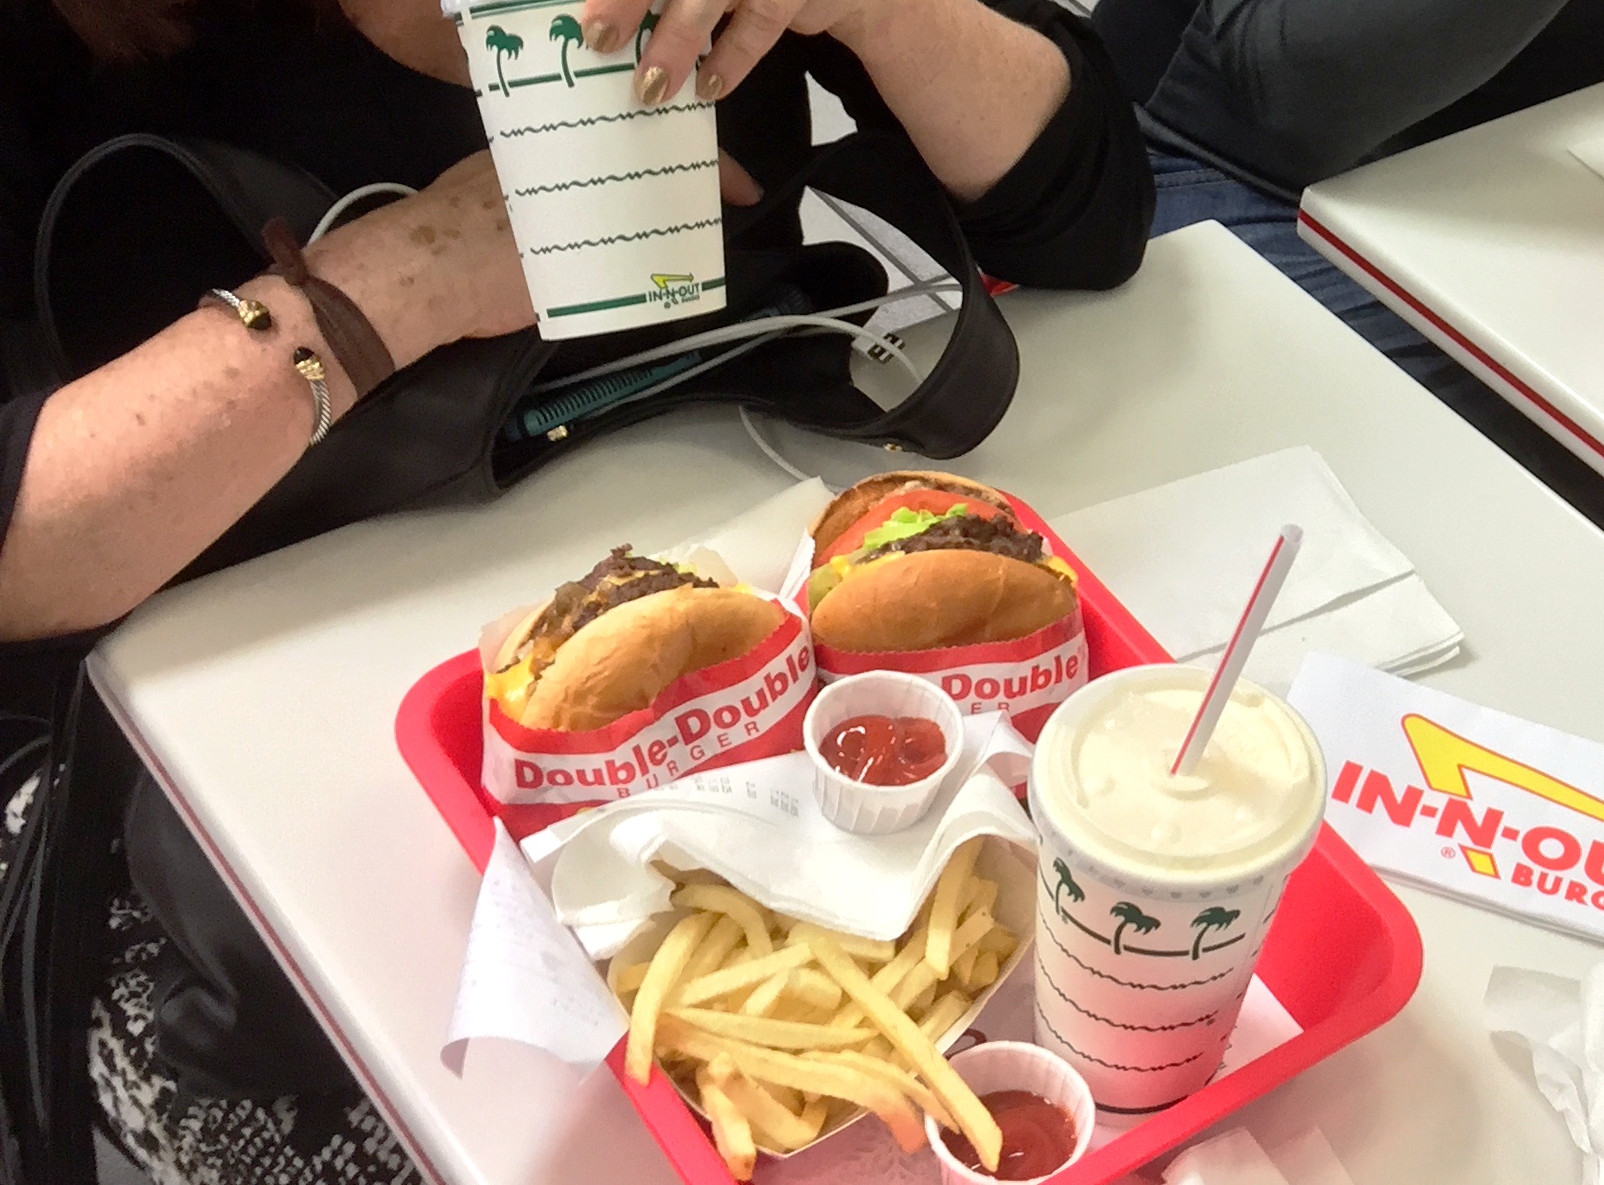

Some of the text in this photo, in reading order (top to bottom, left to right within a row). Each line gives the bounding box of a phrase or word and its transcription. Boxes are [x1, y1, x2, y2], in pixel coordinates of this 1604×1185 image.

[648, 282, 700, 303] IN-N-OUT
[513, 645, 810, 790] Double-Double
[617, 720, 761, 799] BURGER
